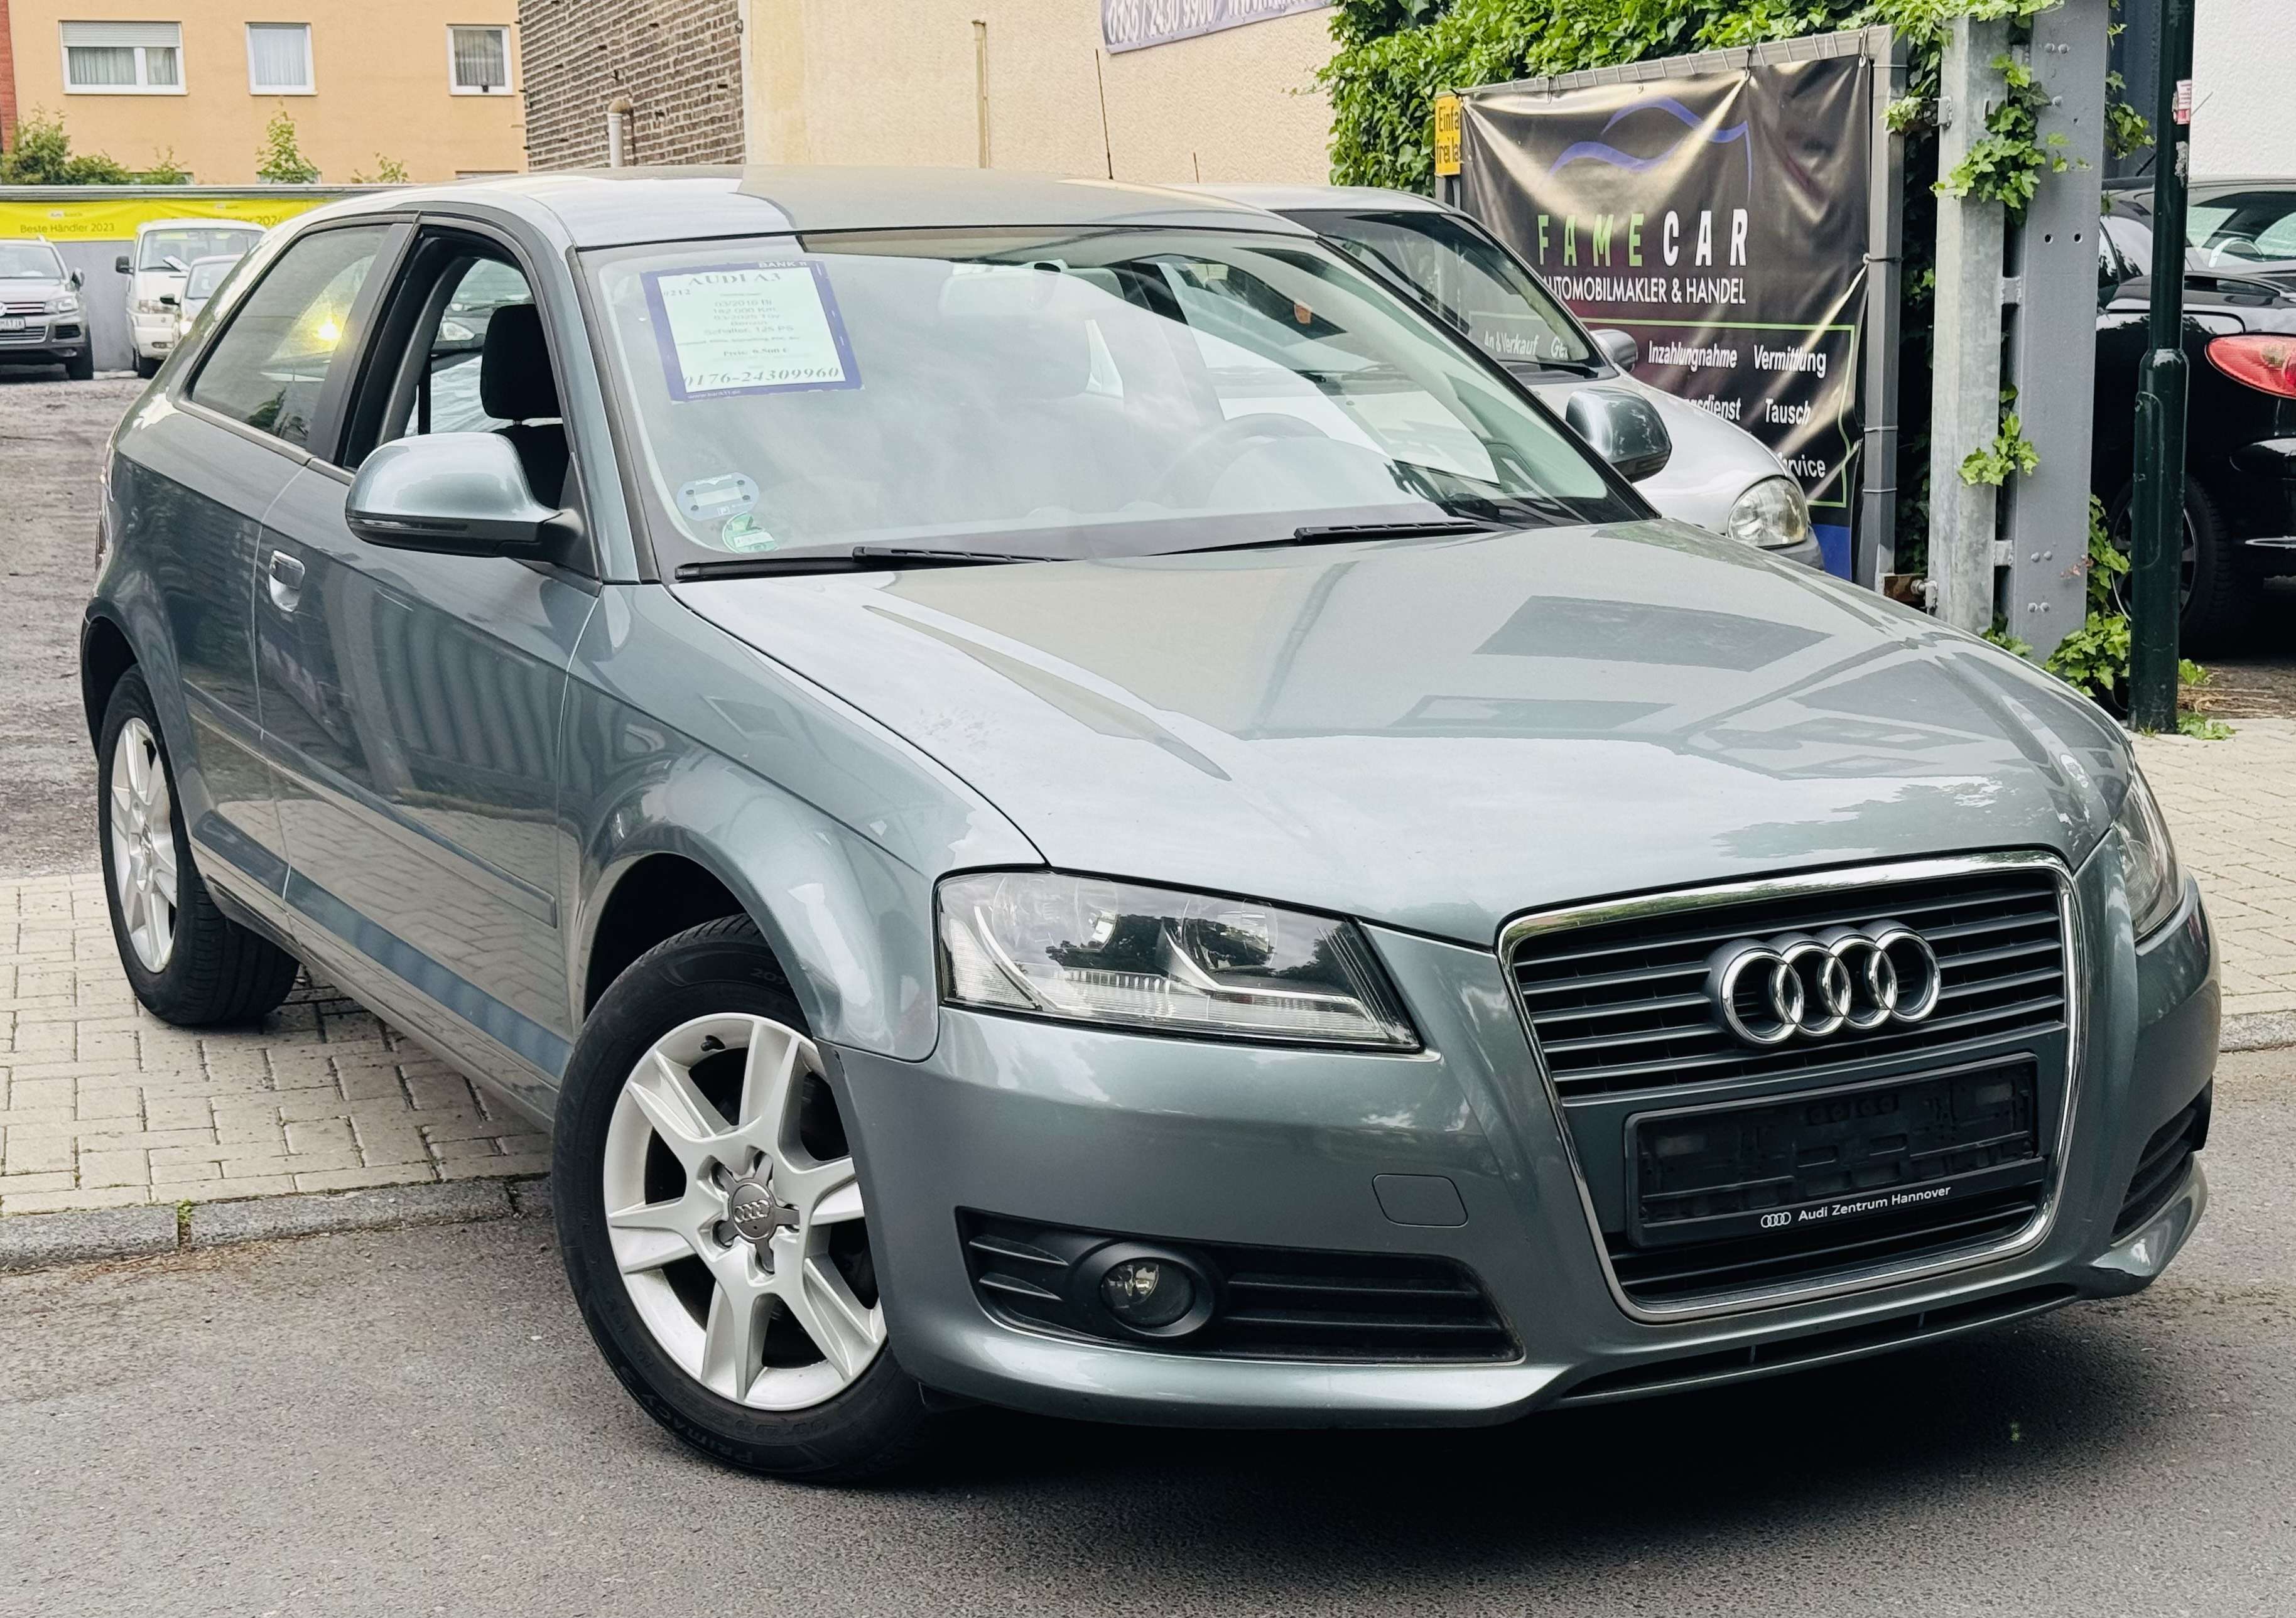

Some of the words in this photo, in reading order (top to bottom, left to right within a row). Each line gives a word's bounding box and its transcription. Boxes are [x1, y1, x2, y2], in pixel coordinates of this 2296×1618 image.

[1438, 105, 1459, 132] Einfa
[20, 224, 48, 234] Beste
[50, 224, 88, 233] Händler
[91, 222, 115, 232] 2023
[689, 274, 746, 286] AUDI
[754, 272, 782, 283] A3
[1671, 278, 1682, 303] &
[1686, 278, 1747, 305] HANDEL
[1484, 331, 1495, 350] An
[1501, 332, 1539, 356] Verkauf
[1648, 340, 1738, 372] Inzahlungnahme
[1753, 344, 1827, 378] Vermittlung
[684, 367, 840, 387] 0176-24309960
[1765, 397, 1812, 425] Tausch
[1797, 1206, 1828, 1222] Audi
[1831, 1198, 1888, 1216] Zentrum
[1891, 1187, 1951, 1206] Hannover
